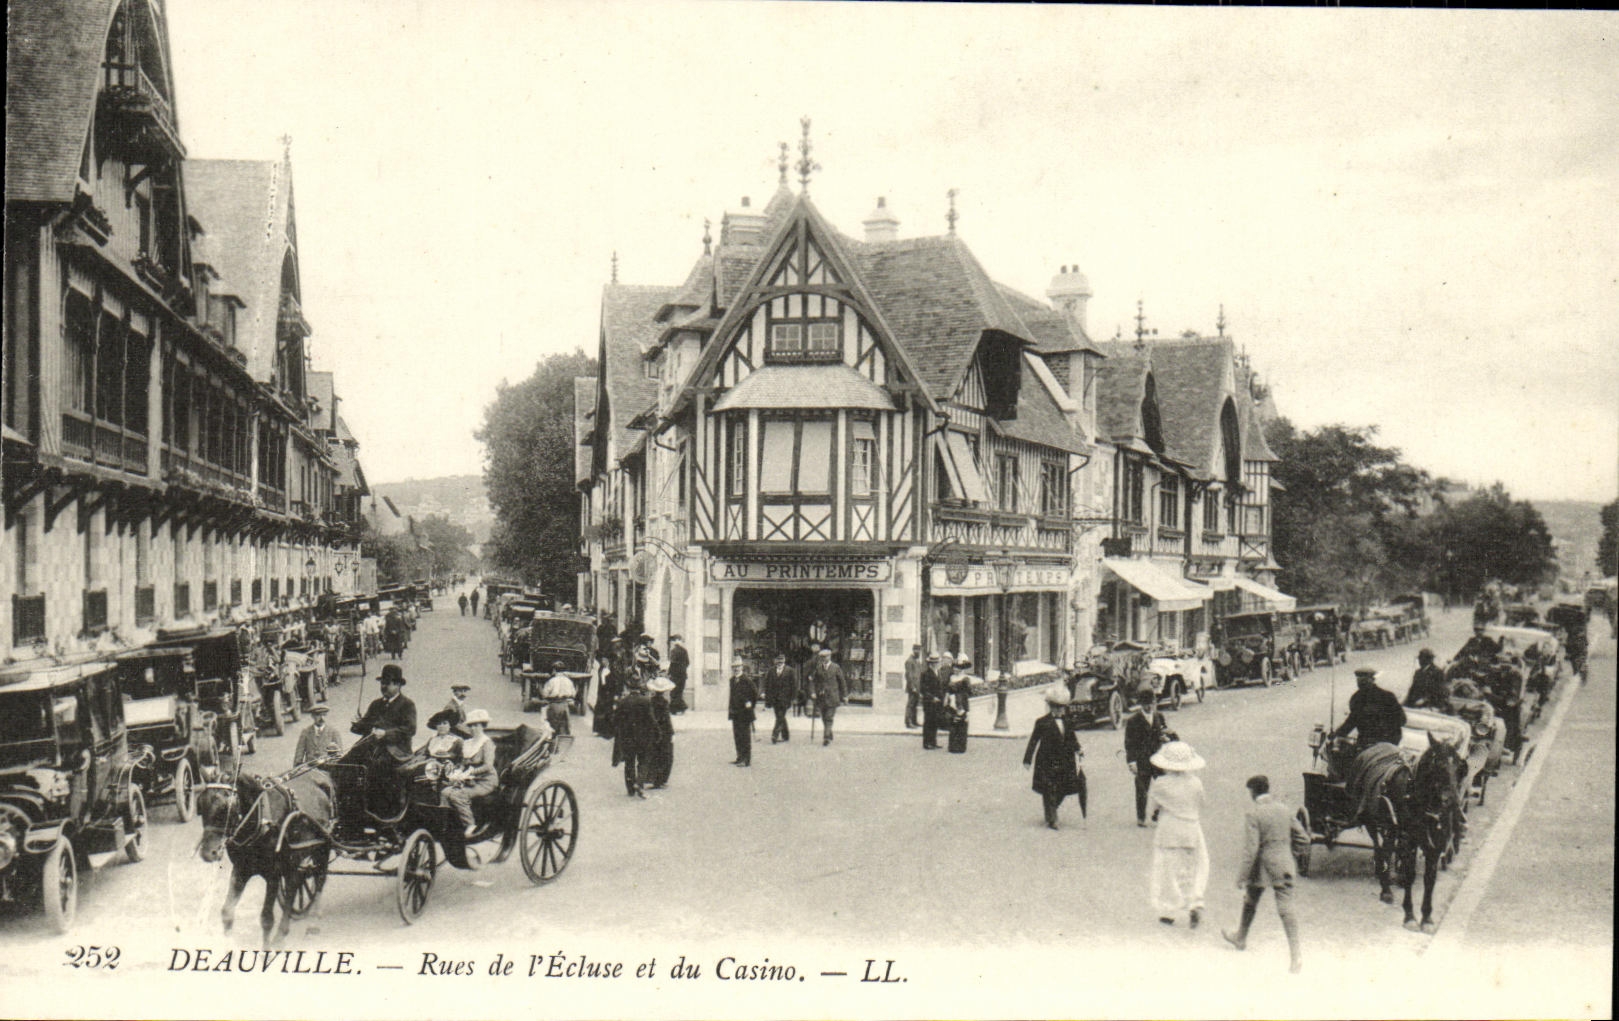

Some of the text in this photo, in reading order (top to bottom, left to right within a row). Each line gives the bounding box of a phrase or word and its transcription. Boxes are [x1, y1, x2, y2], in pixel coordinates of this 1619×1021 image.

[724, 564, 879, 579] AU PRINTEMPS
[974, 570, 1063, 586] PRTEMPS
